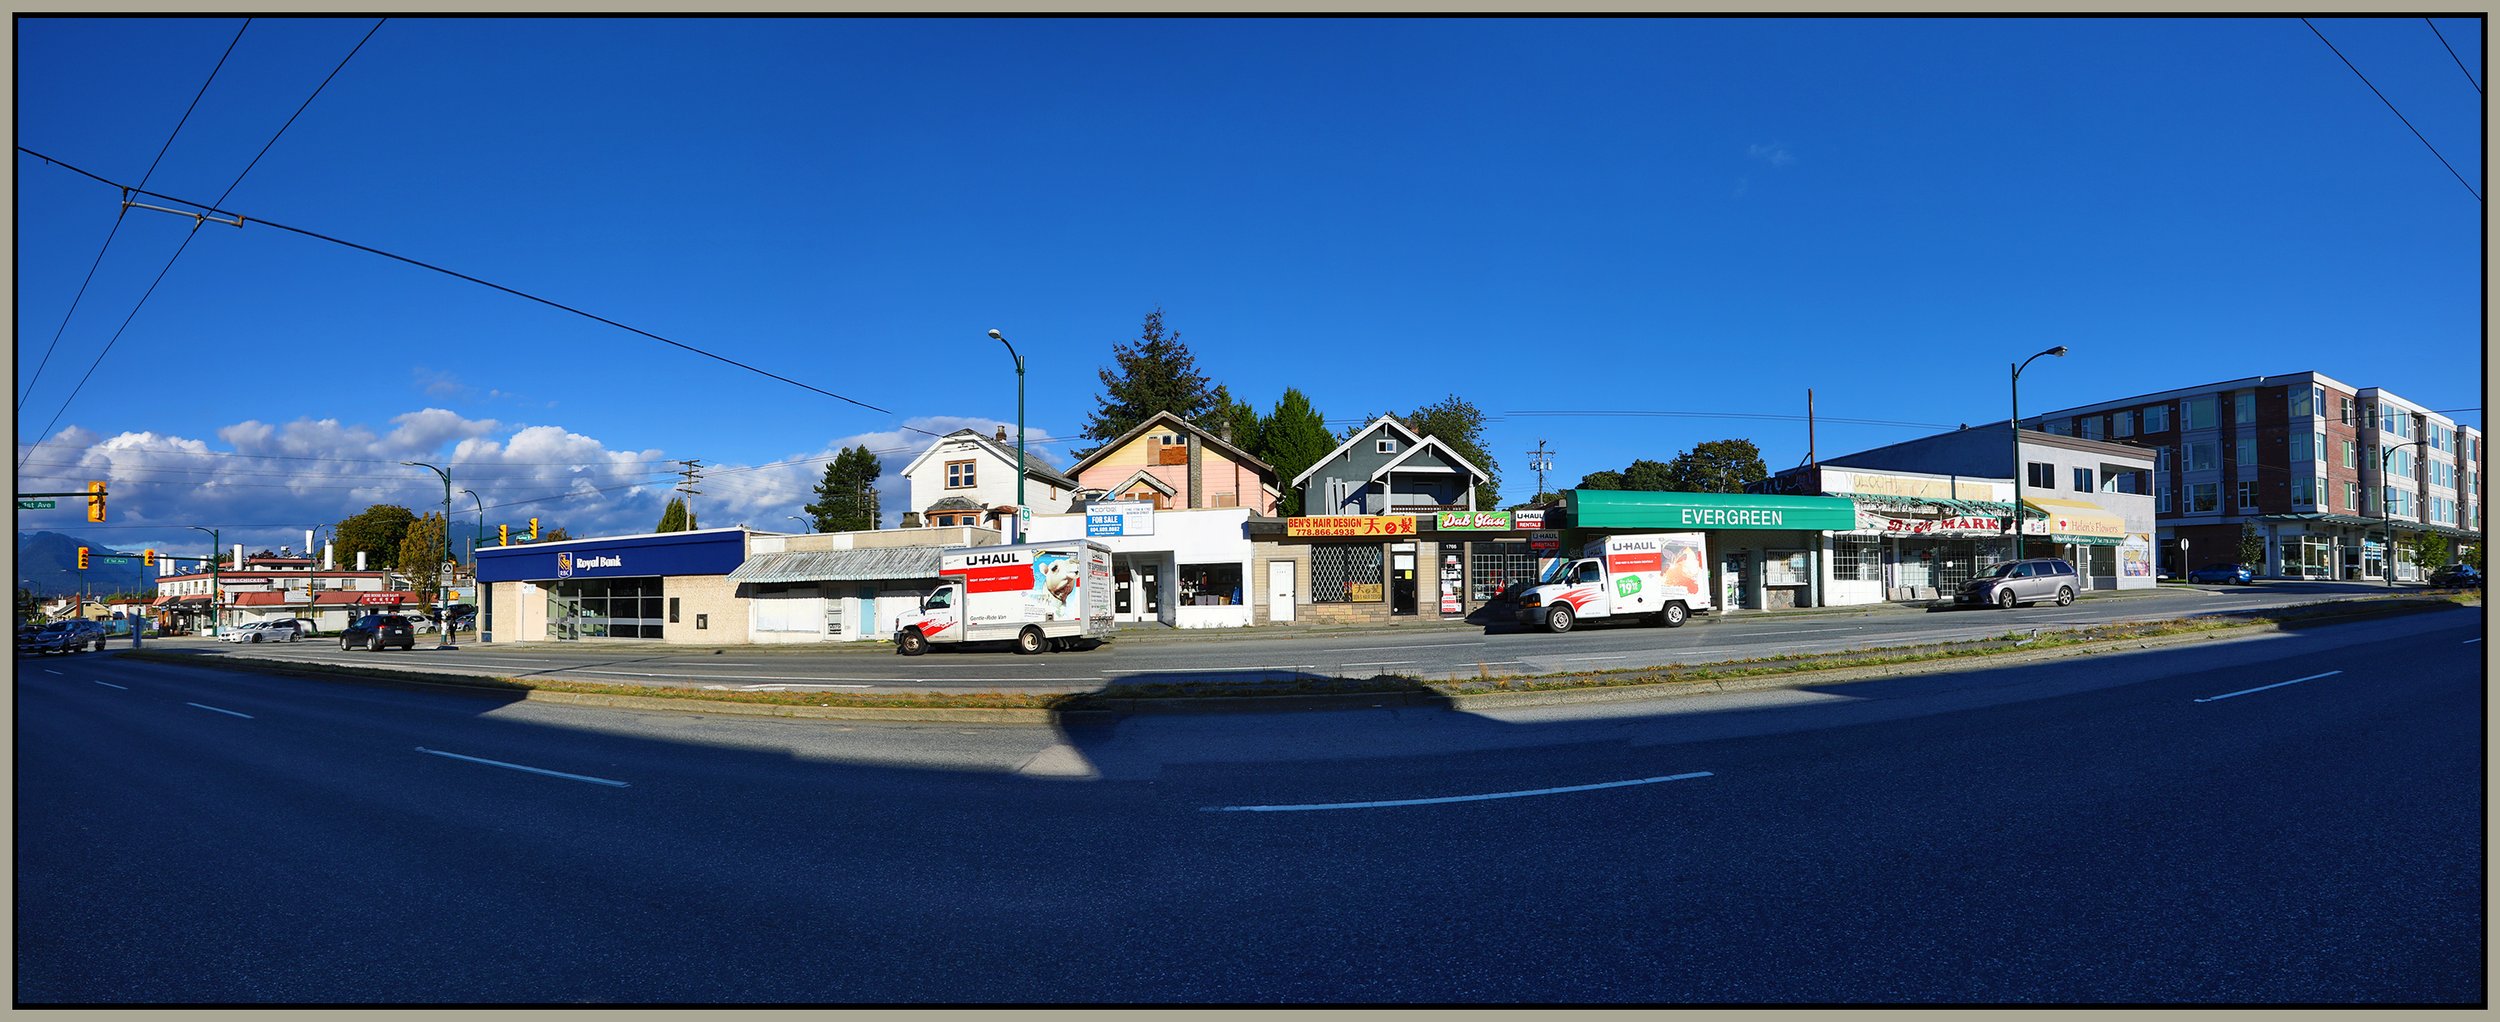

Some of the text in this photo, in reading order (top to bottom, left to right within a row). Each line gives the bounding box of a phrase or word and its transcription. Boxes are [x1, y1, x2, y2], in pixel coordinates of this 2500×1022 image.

[1091, 515, 1118, 524] FOR SALE
[1288, 518, 1362, 528] BEN'S HAIR DESIGN
[1443, 512, 1506, 528] Dab Glass
[1682, 509, 1782, 526] EVERGREEN
[1887, 519, 1903, 531] D
[1904, 523, 1911, 531] &
[2071, 520, 2119, 533] Helen's Flowers
[1296, 528, 1356, 536] 778.866.4938
[1612, 541, 1656, 551] U-HAUL
[576, 555, 622, 571] Royal Bank
[966, 553, 1020, 566] U-HAUL
